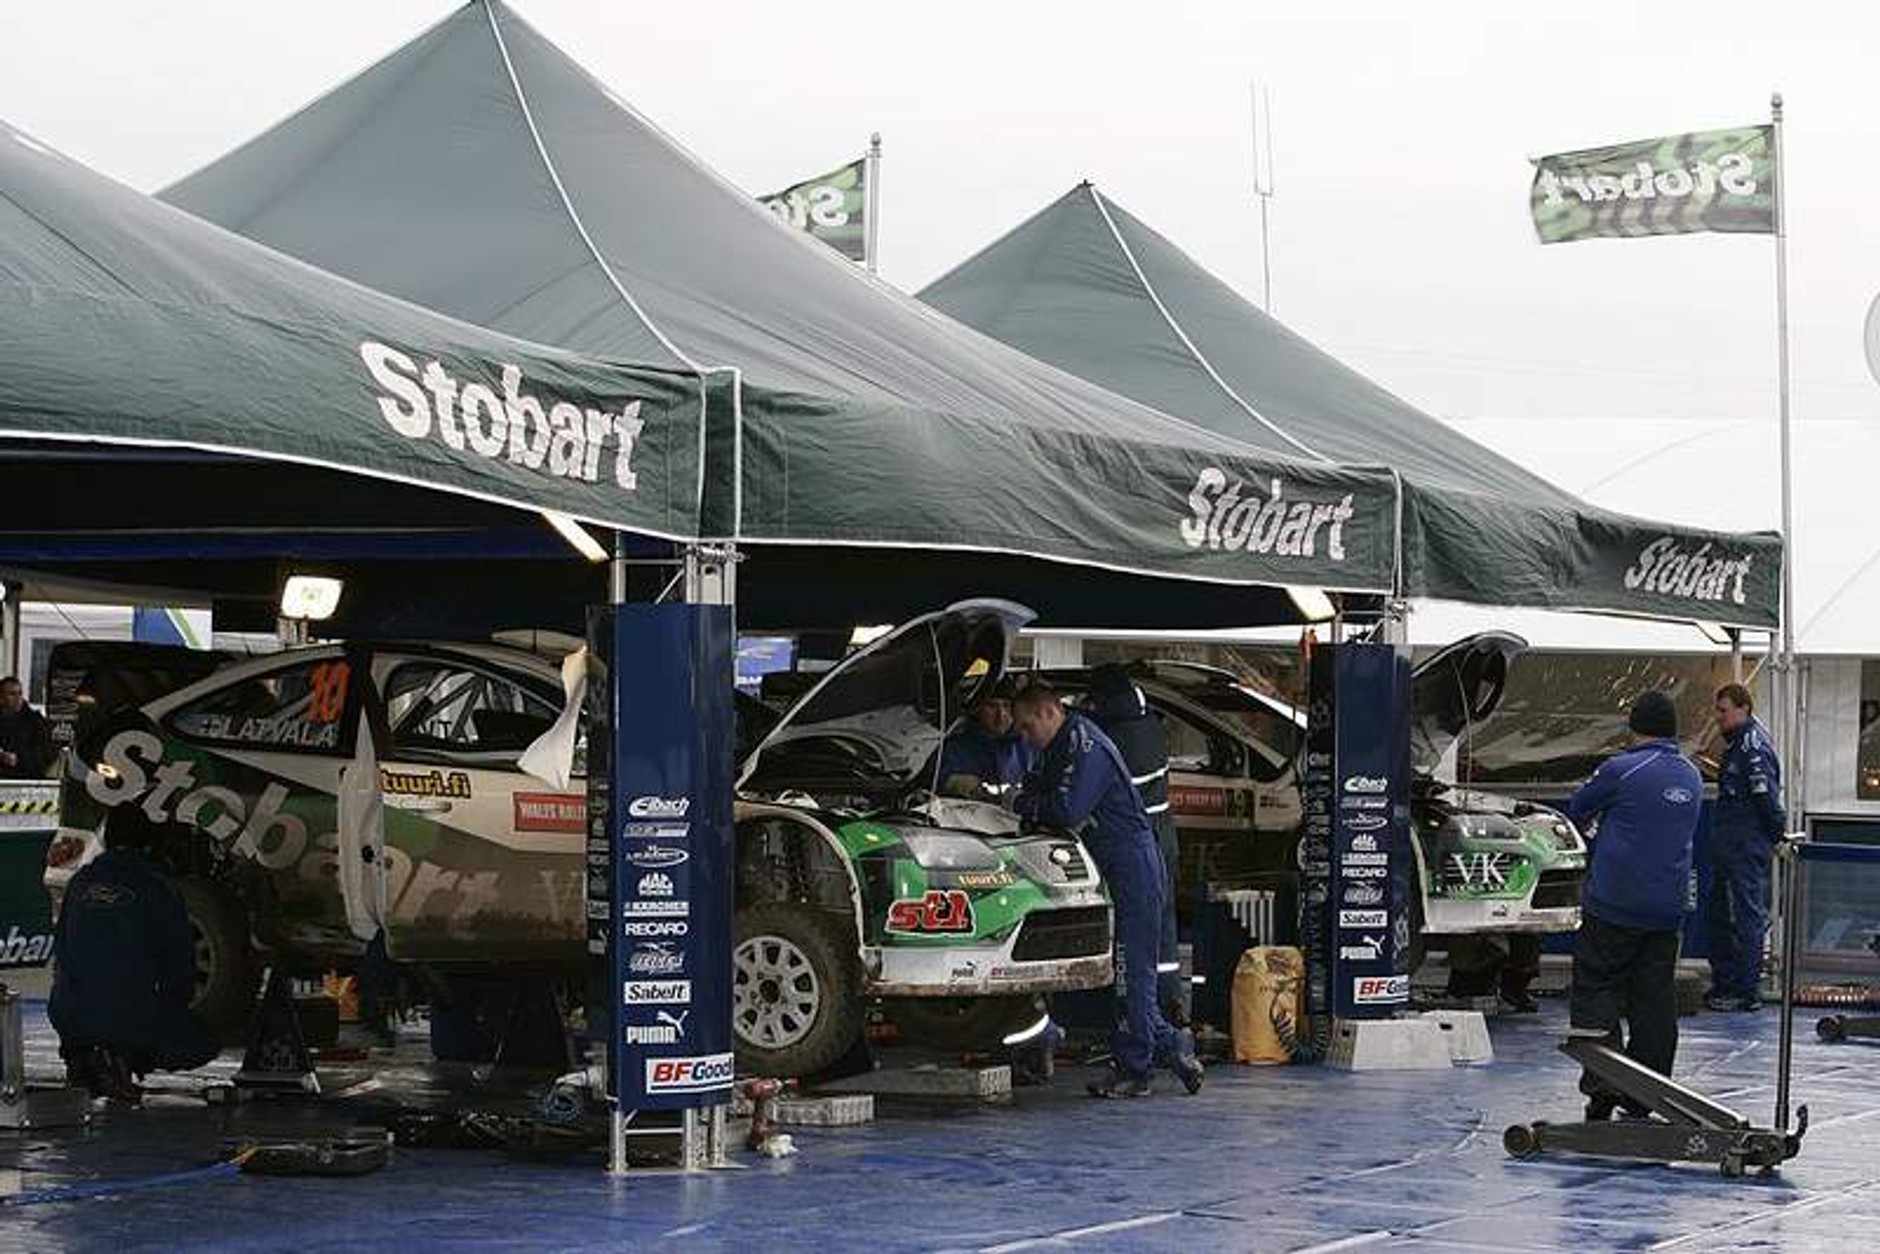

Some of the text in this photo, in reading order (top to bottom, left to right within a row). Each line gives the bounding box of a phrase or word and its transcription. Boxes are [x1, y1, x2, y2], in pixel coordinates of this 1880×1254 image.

[360, 341, 644, 490] Stobart
[1180, 467, 1354, 560] Stobart
[1624, 537, 1752, 605] Stobart
[1450, 852, 1506, 885] VK
[625, 921, 688, 936] RECARO
[628, 984, 684, 1001] Sabelt
[627, 1026, 677, 1044] PUMA
